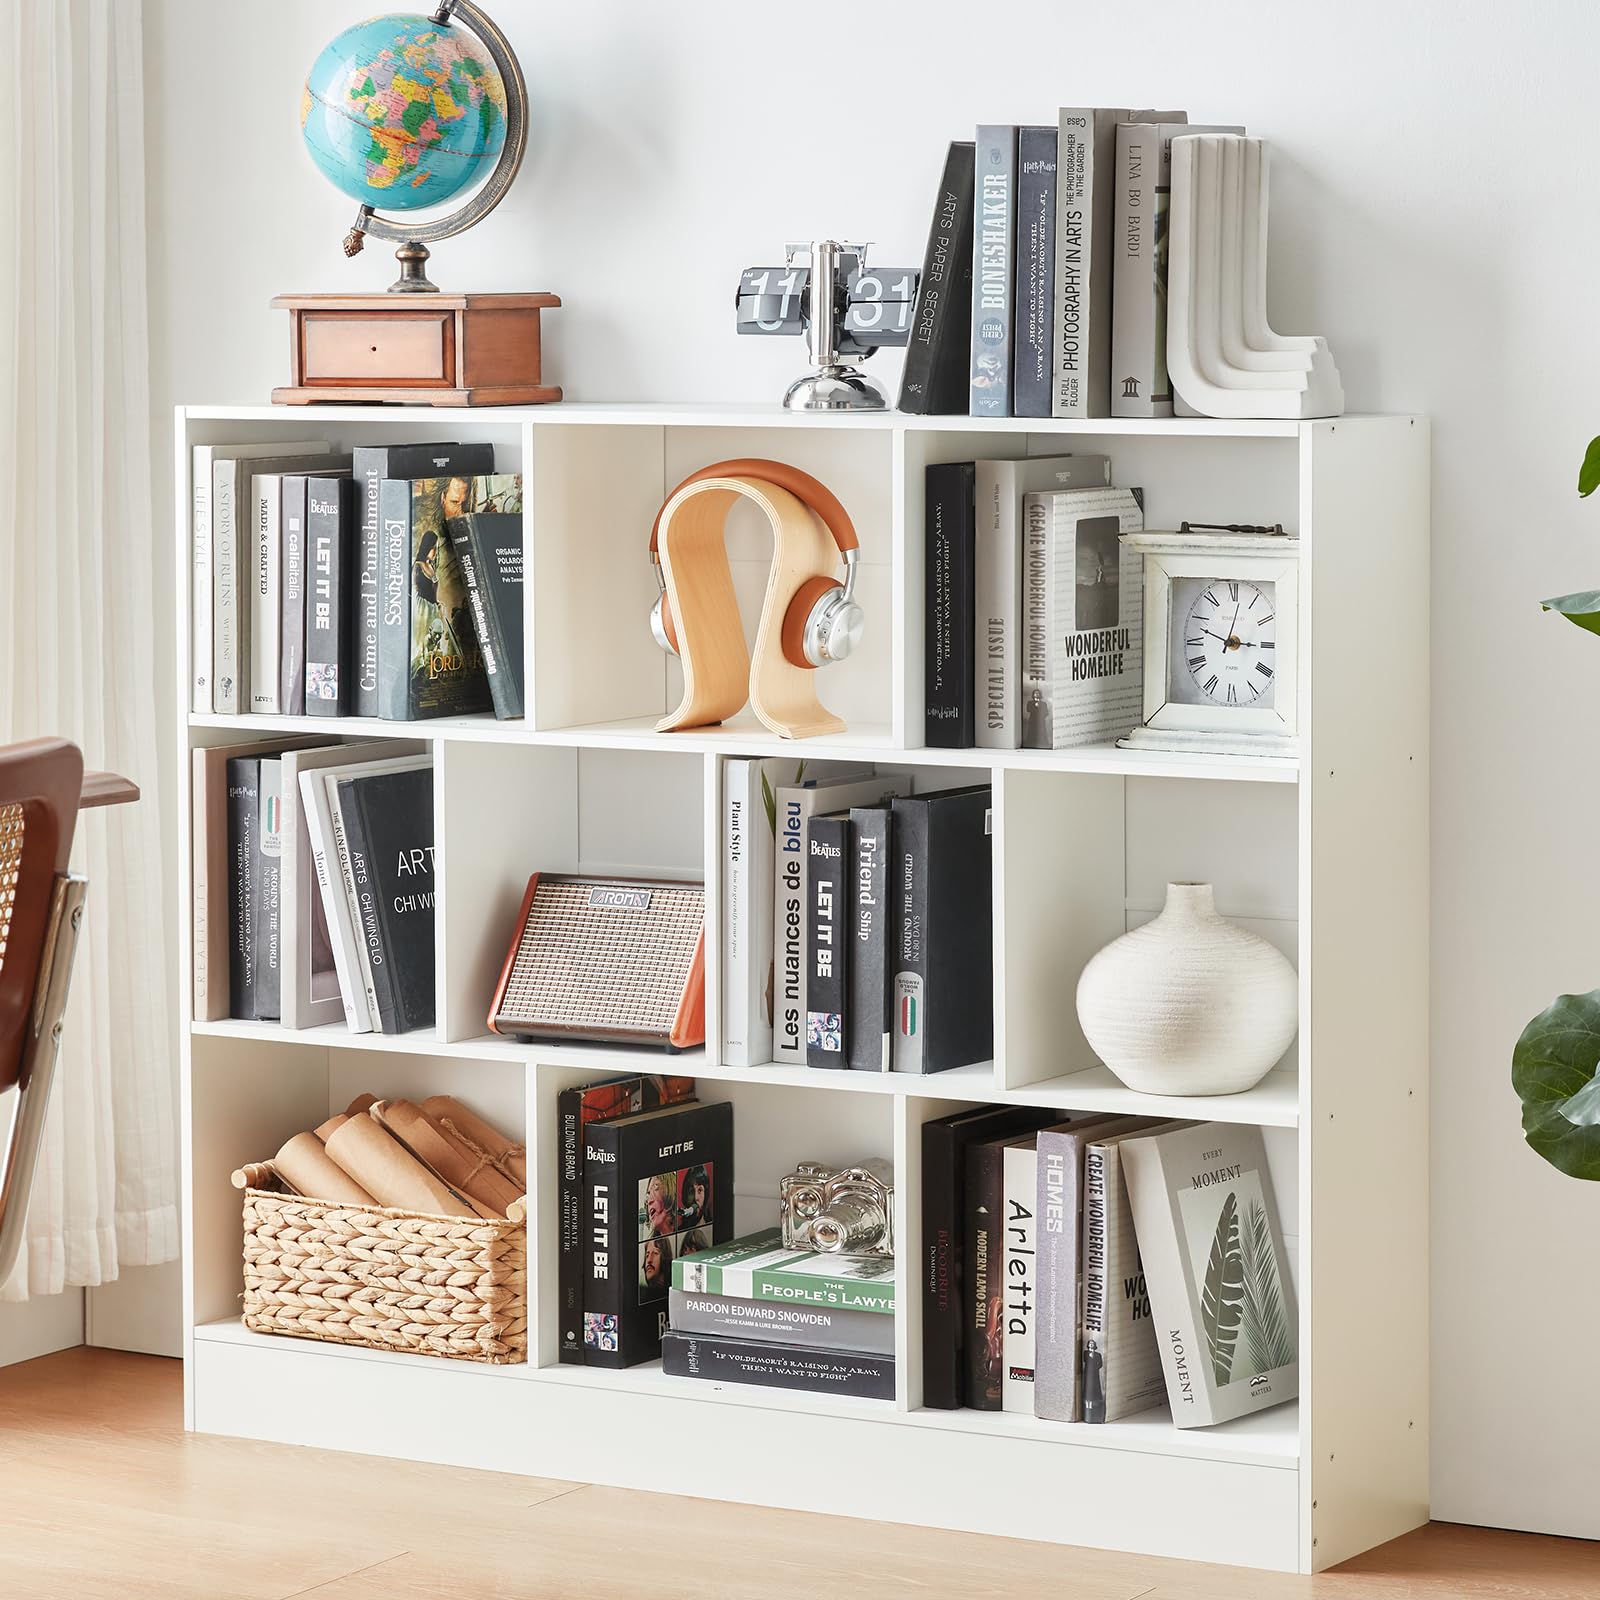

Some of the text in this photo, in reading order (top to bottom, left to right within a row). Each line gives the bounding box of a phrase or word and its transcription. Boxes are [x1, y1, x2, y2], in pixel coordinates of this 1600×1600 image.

[1066, 117, 1086, 128] Casa
[1066, 133, 1076, 206] THE PHOTOGRAPHER
[1076, 143, 1085, 197] IN THE GARDEN
[1127, 145, 1142, 259] LINA BO BARDI
[981, 173, 1008, 310] BONESHAKER
[918, 191, 958, 345] ARTS PAPER SECRET
[1063, 210, 1082, 371] PHOTOGRAPHY IN ARTS
[1030, 299, 1036, 311] TO
[1037, 326, 1044, 343] AN
[1061, 377, 1070, 407] IN FULL
[220, 492, 231, 607] STORY OF RUINS
[260, 498, 268, 595] MADE & CRAFTED
[288, 533, 300, 600] caliaitalia
[495, 548, 521, 556] ORGANIC
[936, 540, 942, 557] AN
[315, 537, 331, 630] LET IT BE
[360, 468, 378, 692] Crime and Punishment
[384, 518, 406, 626] LORD RINGS
[461, 554, 477, 587] Analysis
[944, 572, 950, 585] TO
[1029, 504, 1046, 681] CREATE WONDERFUL HOMELIFE
[1064, 628, 1130, 658] WONDERFUL
[987, 618, 1004, 729] SPECIAL ISSUE
[1071, 653, 1124, 681] HOMELIFE
[335, 826, 351, 876] KINFOLK
[729, 801, 741, 862] Plant Style
[263, 866, 270, 878] IN
[263, 879, 270, 889] 80
[315, 850, 328, 887] Monet
[352, 851, 368, 884] ARTS
[857, 836, 877, 941] Friend Ship
[239, 911, 244, 922] TO
[269, 866, 278, 969] AROUND THE WORLD
[361, 893, 373, 912] CHI
[394, 894, 417, 913] CHI
[780, 801, 801, 1051] Les nuances de bleu
[904, 853, 913, 962] AROUND THE WORLD
[246, 936, 251, 952] AN
[365, 914, 379, 947] WING
[817, 880, 833, 978] LET IT BE
[912, 915, 920, 962] IN 80 DAYS
[370, 948, 382, 965] LO
[564, 1114, 576, 1181] BUILDING BRAND
[659, 1140, 694, 1158] LET IT BE
[1202, 1148, 1223, 1161] EVERY
[1046, 1154, 1064, 1233] HOMES
[1191, 1164, 1241, 1190] MOMENT
[593, 1185, 609, 1280] LET IT BE
[1086, 1153, 1104, 1332] CREATE WONDERFUL HOMELIFE
[824, 1282, 845, 1290] THE
[929, 1245, 937, 1293] DOMINIQUE
[975, 1229, 987, 1329] MODERN LAMO SKILL
[1008, 1199, 1035, 1335] Arletta
[686, 1300, 831, 1326] PARDON EDWARD SNOWDEN
[762, 1283, 838, 1303] PEOPLE'S
[740, 1363, 767, 1372] THEN
[775, 1367, 805, 1377] WANT
[789, 1361, 829, 1371] RAISING
[849, 1368, 880, 1376] ARMY,
[1169, 1329, 1194, 1404] MOMENT
[1250, 1385, 1272, 1397] MATTERS
